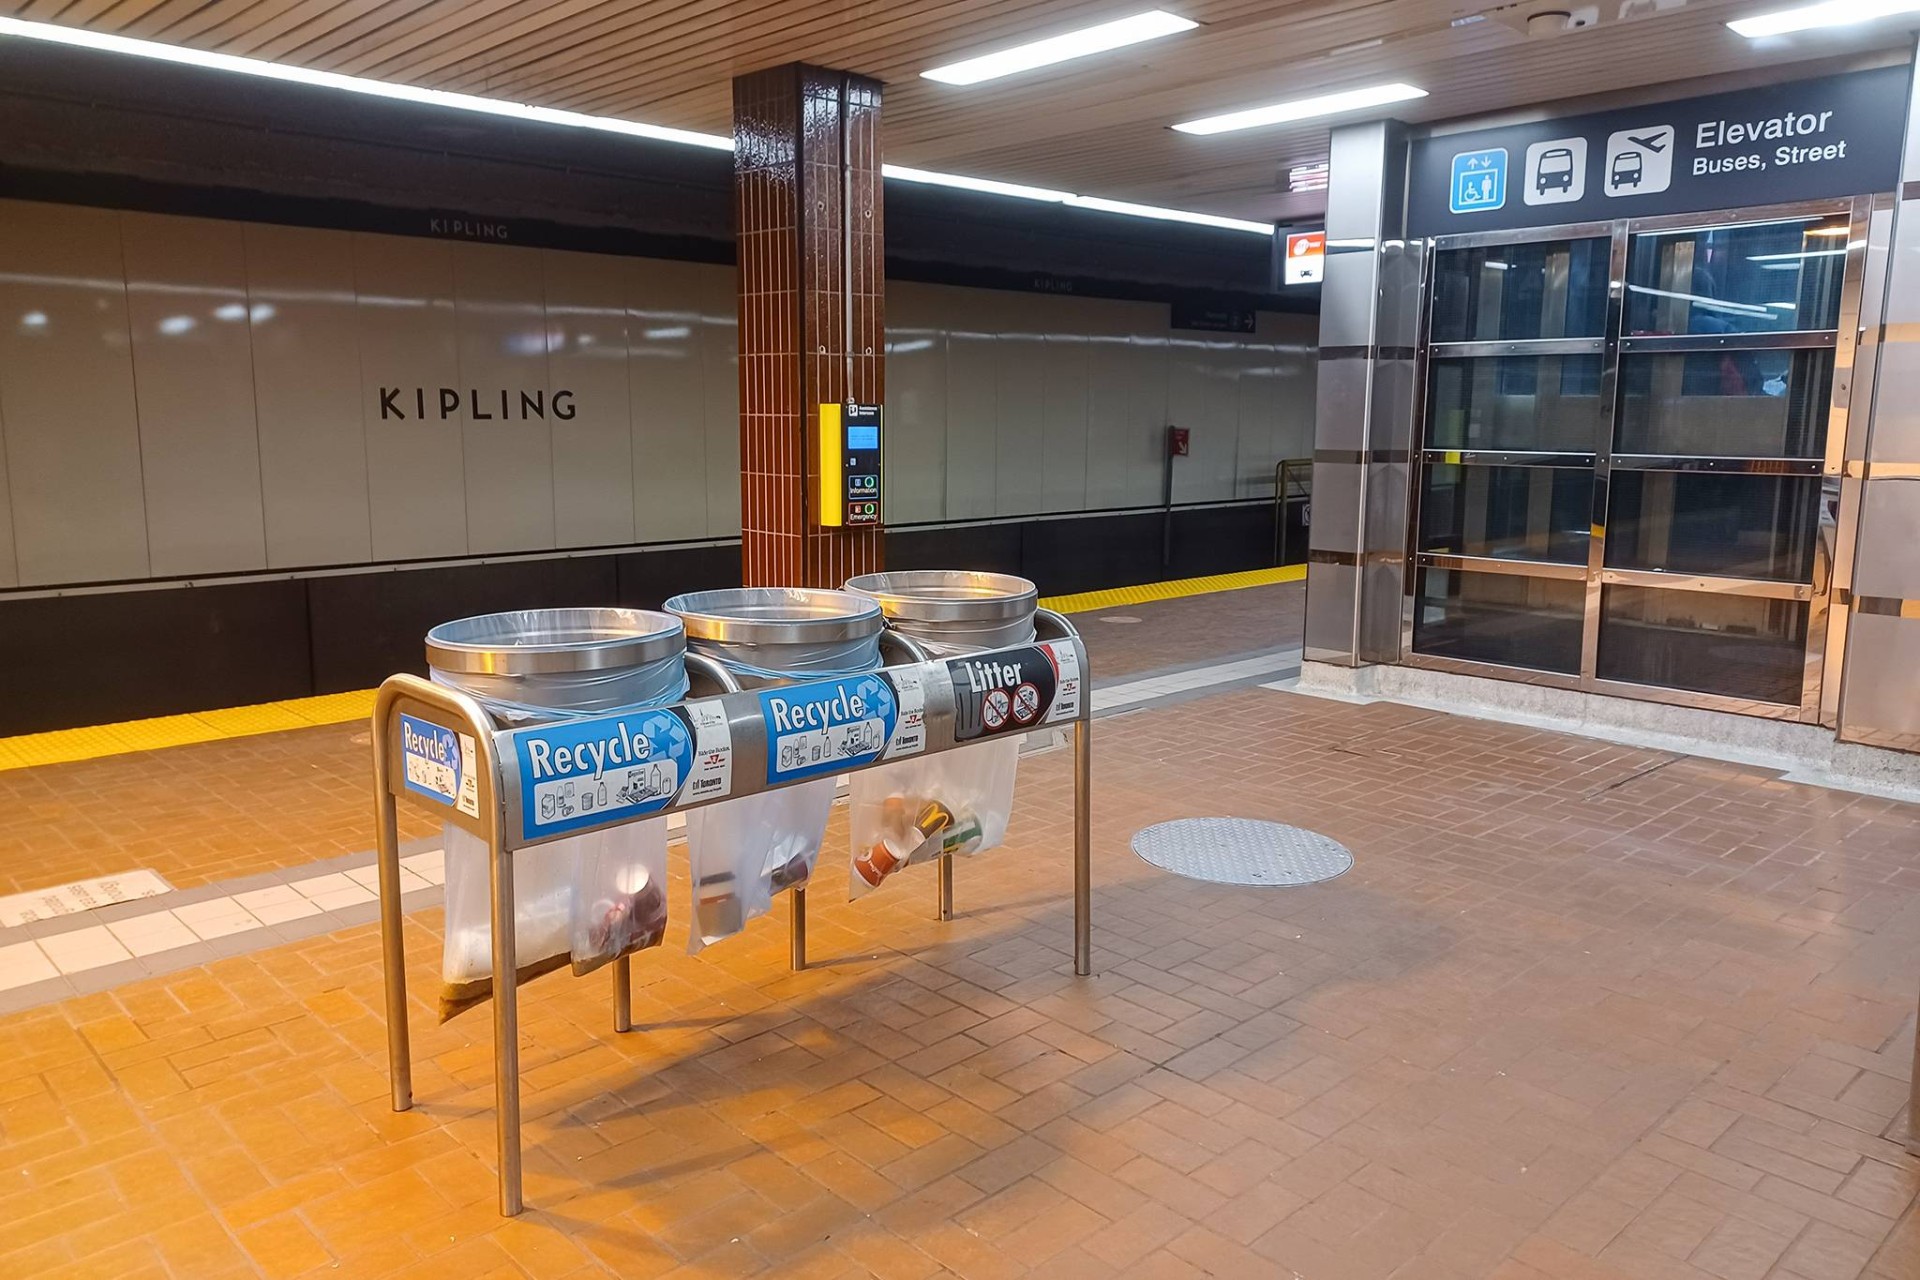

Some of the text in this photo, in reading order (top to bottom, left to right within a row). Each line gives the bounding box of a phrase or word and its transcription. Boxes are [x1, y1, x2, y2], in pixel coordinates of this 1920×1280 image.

[1695, 111, 1833, 149] Elevator
[1692, 139, 1847, 176] Buses, Street
[429, 218, 509, 240] KIPLING
[379, 387, 576, 420] KIPLING
[850, 513, 877, 521] Emergency
[965, 660, 1022, 693] Litter
[769, 685, 865, 735] Recycle
[403, 721, 446, 762] Recycle
[526, 722, 651, 781] Recycle
